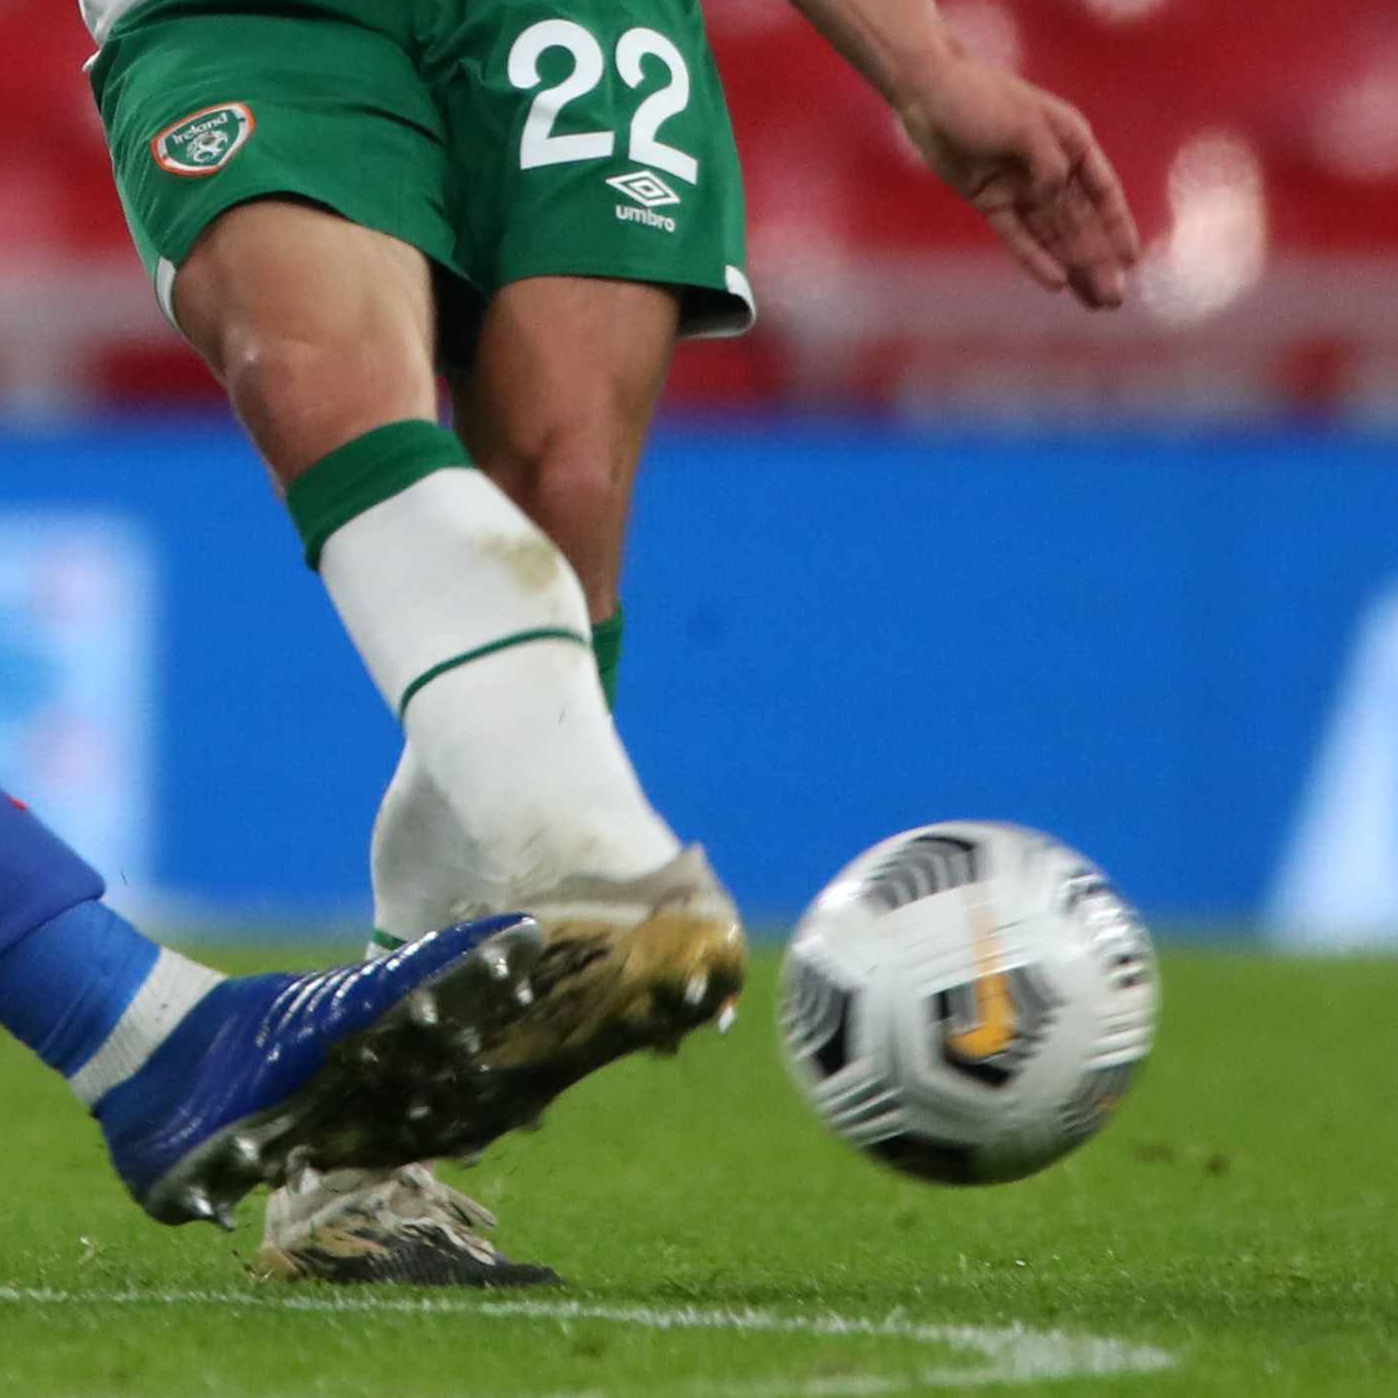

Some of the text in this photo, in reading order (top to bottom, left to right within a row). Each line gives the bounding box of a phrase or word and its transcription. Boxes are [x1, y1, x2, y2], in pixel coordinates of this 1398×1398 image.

[507, 18, 699, 187] 22
[171, 112, 229, 145] Ireland
[615, 204, 676, 233] umbro
